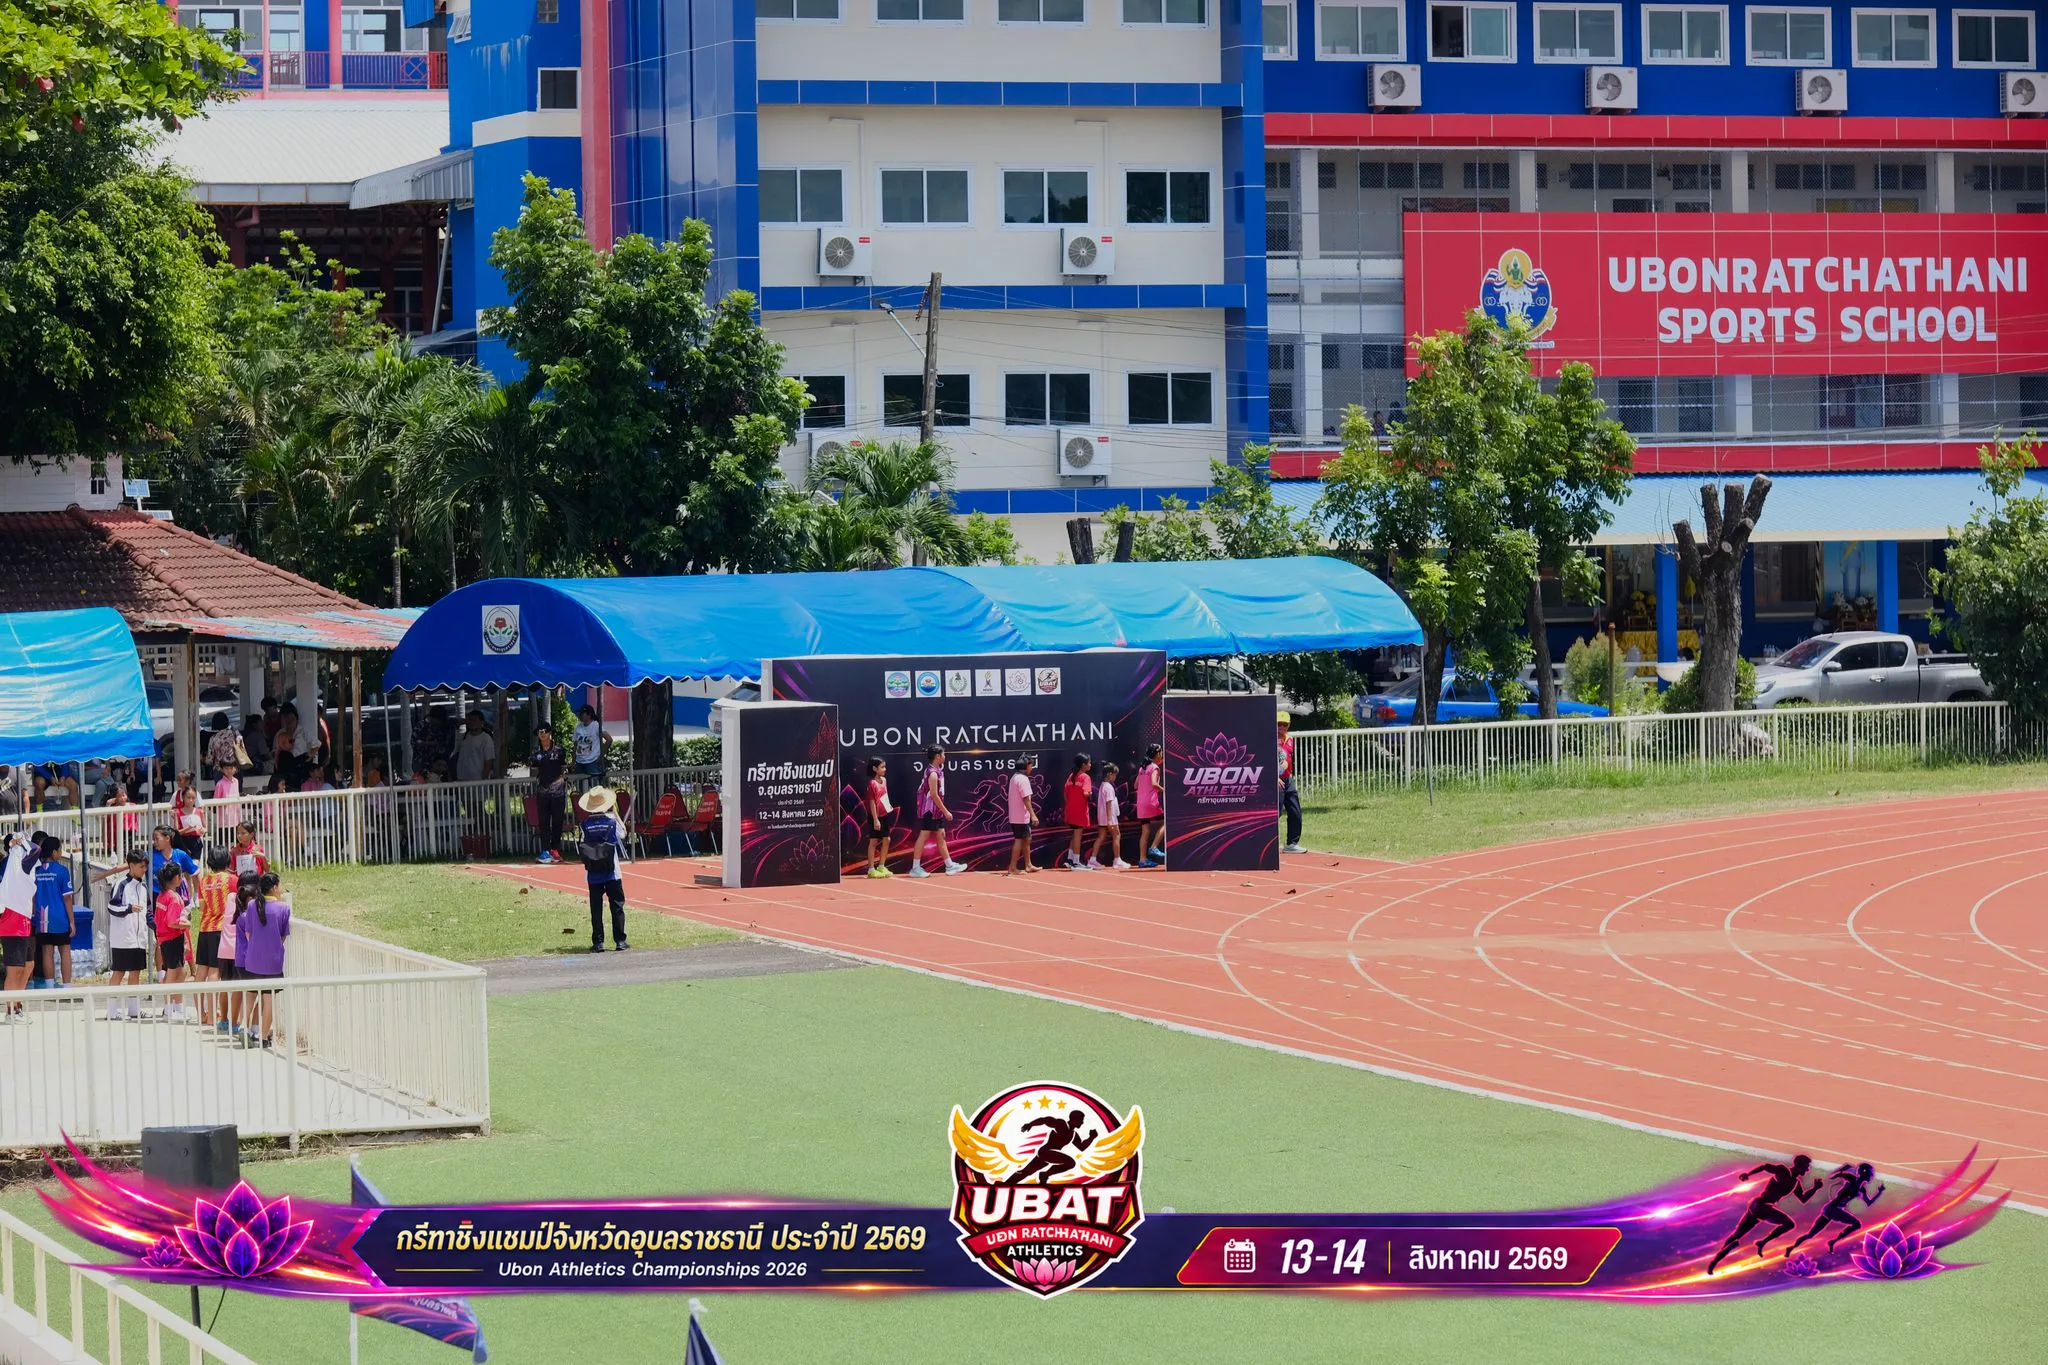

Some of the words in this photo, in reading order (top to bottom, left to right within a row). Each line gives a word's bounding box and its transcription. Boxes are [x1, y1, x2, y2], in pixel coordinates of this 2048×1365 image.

[1608, 256, 2029, 294] UBONRATCHATHANI
[1657, 306, 1817, 344] SPORTS
[1840, 306, 1998, 343] SCHOOL
[839, 727, 922, 747] UBON
[936, 721, 1114, 745] RATCHATHANI
[1183, 766, 1264, 785] UBON
[1184, 785, 1260, 796] ATHLETICS
[759, 811, 780, 820] 12-14
[807, 809, 824, 817] 2569
